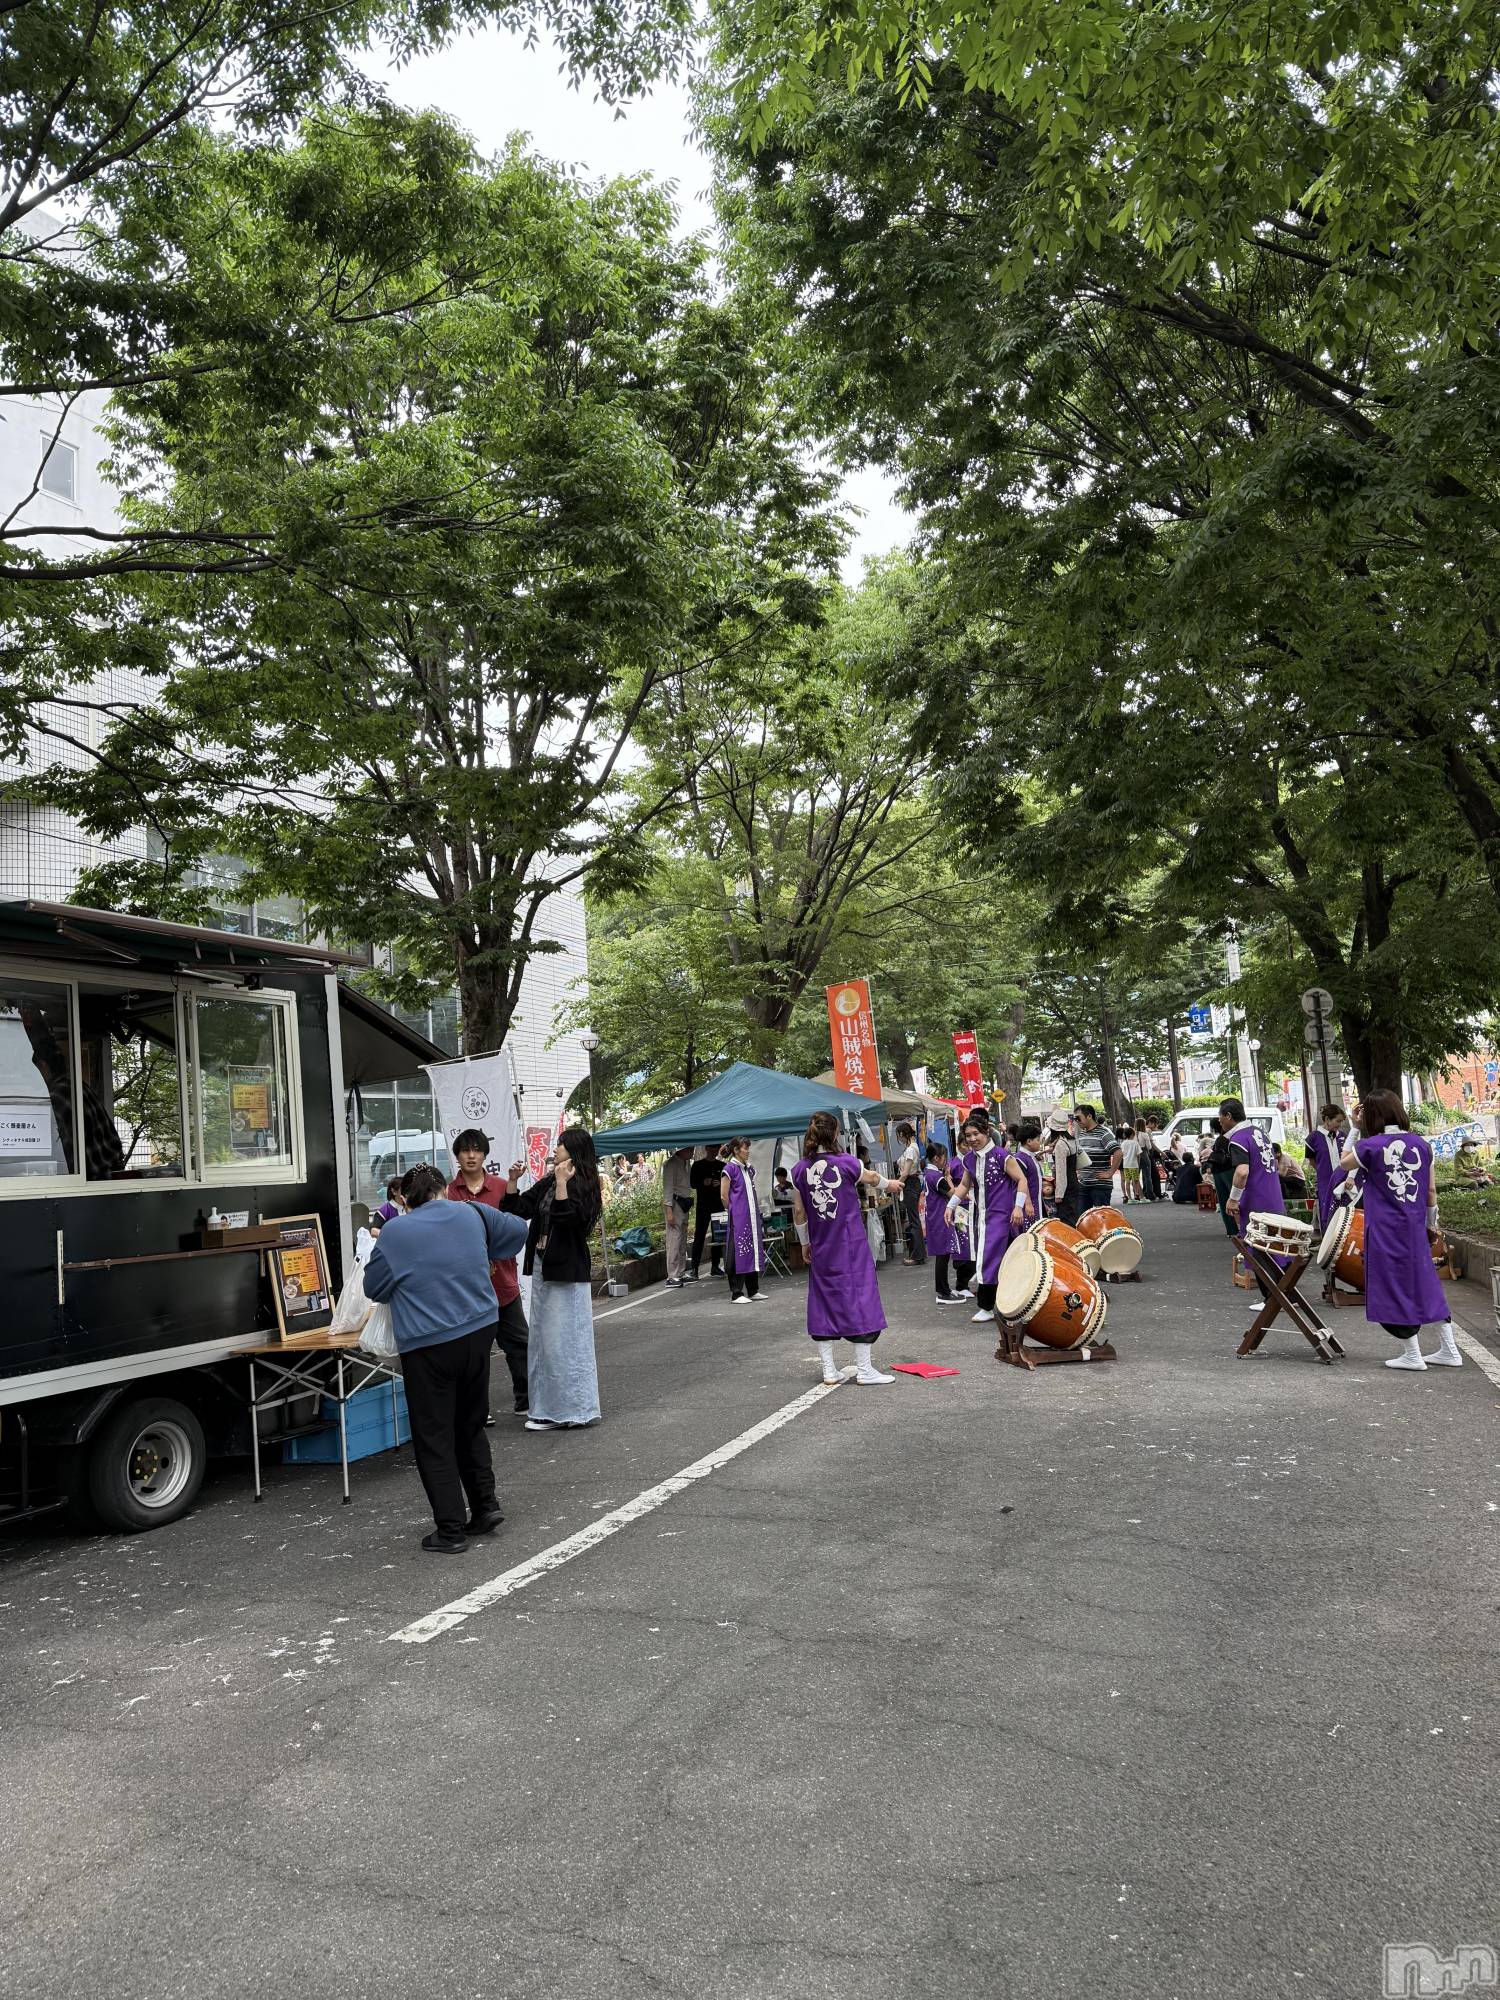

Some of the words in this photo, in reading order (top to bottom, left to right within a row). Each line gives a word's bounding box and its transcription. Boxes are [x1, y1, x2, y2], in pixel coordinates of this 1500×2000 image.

[840, 1017, 866, 1095] 山賊焼き
[859, 1010, 871, 1047] 信州名物
